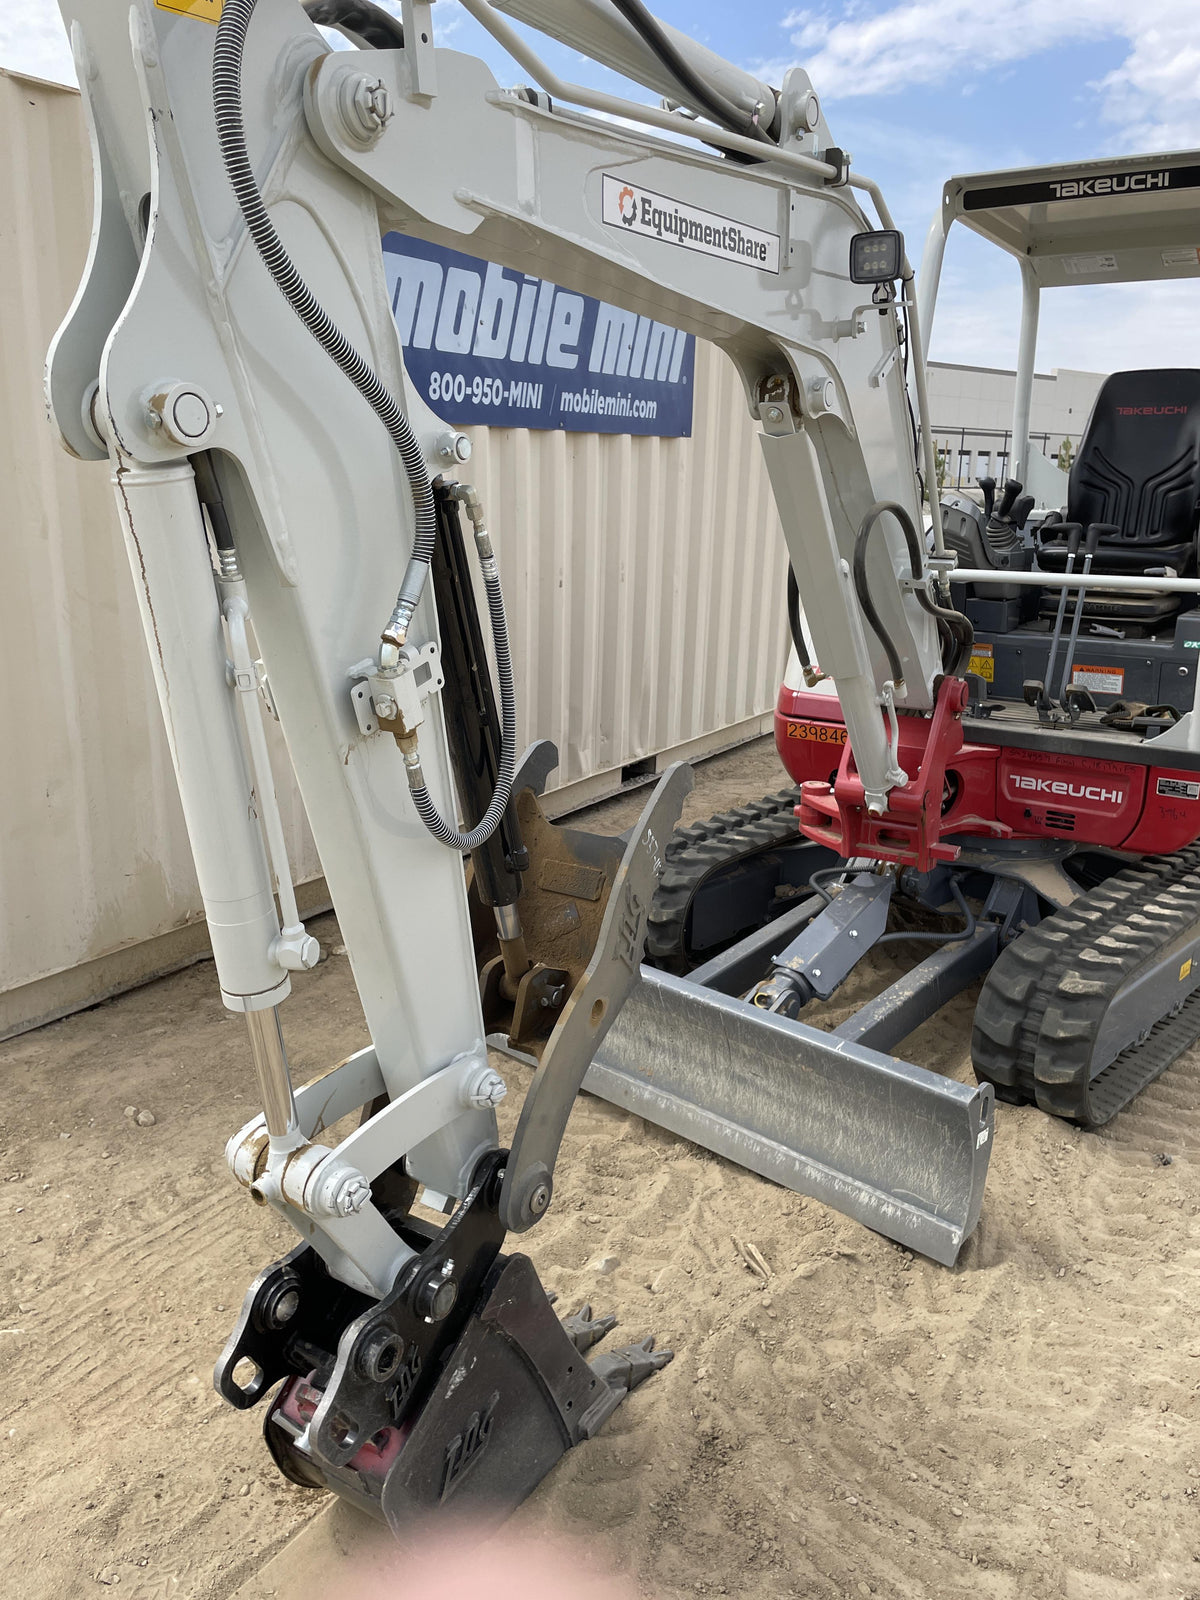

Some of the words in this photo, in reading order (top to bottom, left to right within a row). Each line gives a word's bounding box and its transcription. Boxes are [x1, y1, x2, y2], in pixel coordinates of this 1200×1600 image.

[1050, 172, 1169, 198] TAKEUCHI
[641, 197, 768, 262] EquipmentShare
[382, 252, 585, 370] mobile
[588, 301, 687, 385] mini
[428, 371, 544, 411] 800-950-MINI
[559, 388, 658, 420] mobilemini.com
[788, 723, 848, 745] 239846
[1010, 774, 1123, 805] TAKEUCHI
